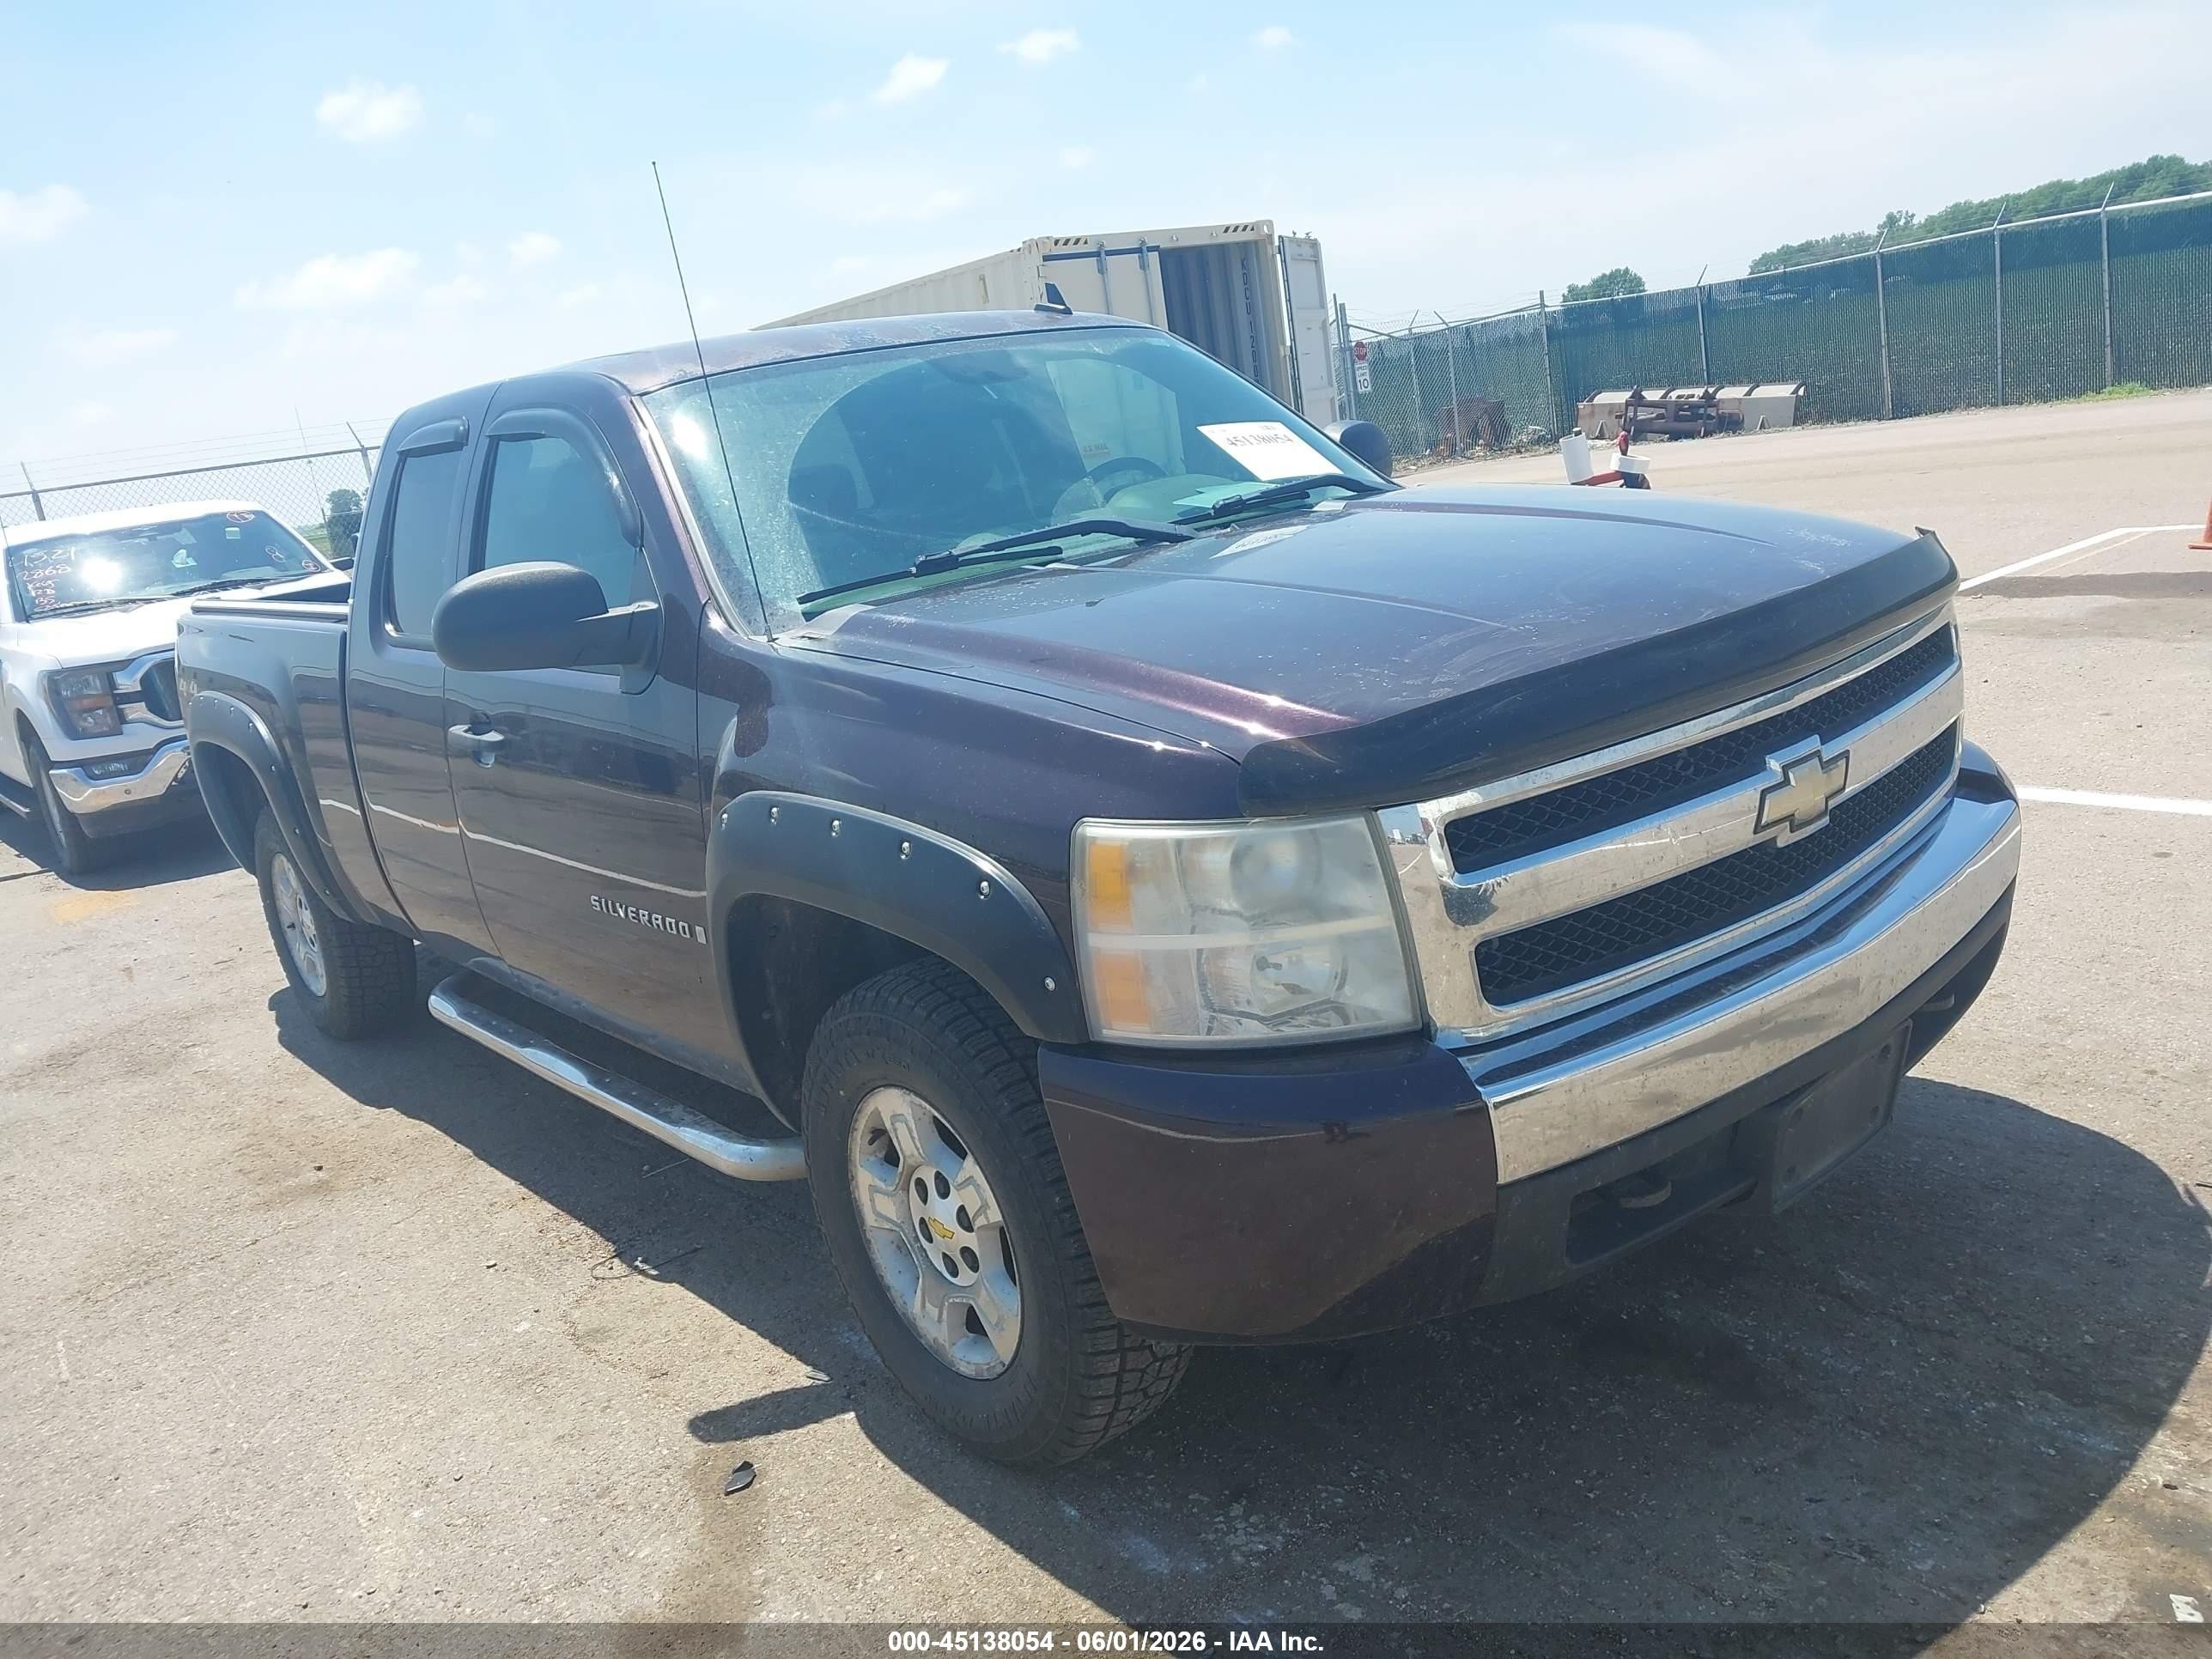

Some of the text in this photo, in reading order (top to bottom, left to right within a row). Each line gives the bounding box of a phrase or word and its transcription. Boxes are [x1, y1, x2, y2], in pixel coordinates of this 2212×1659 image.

[1241, 258, 1251, 315] KOCU
[1353, 347, 1367, 356] STOP
[1358, 378, 1370, 390] 10
[179, 678, 198, 696] 44
[590, 894, 691, 939] SILVERADO
